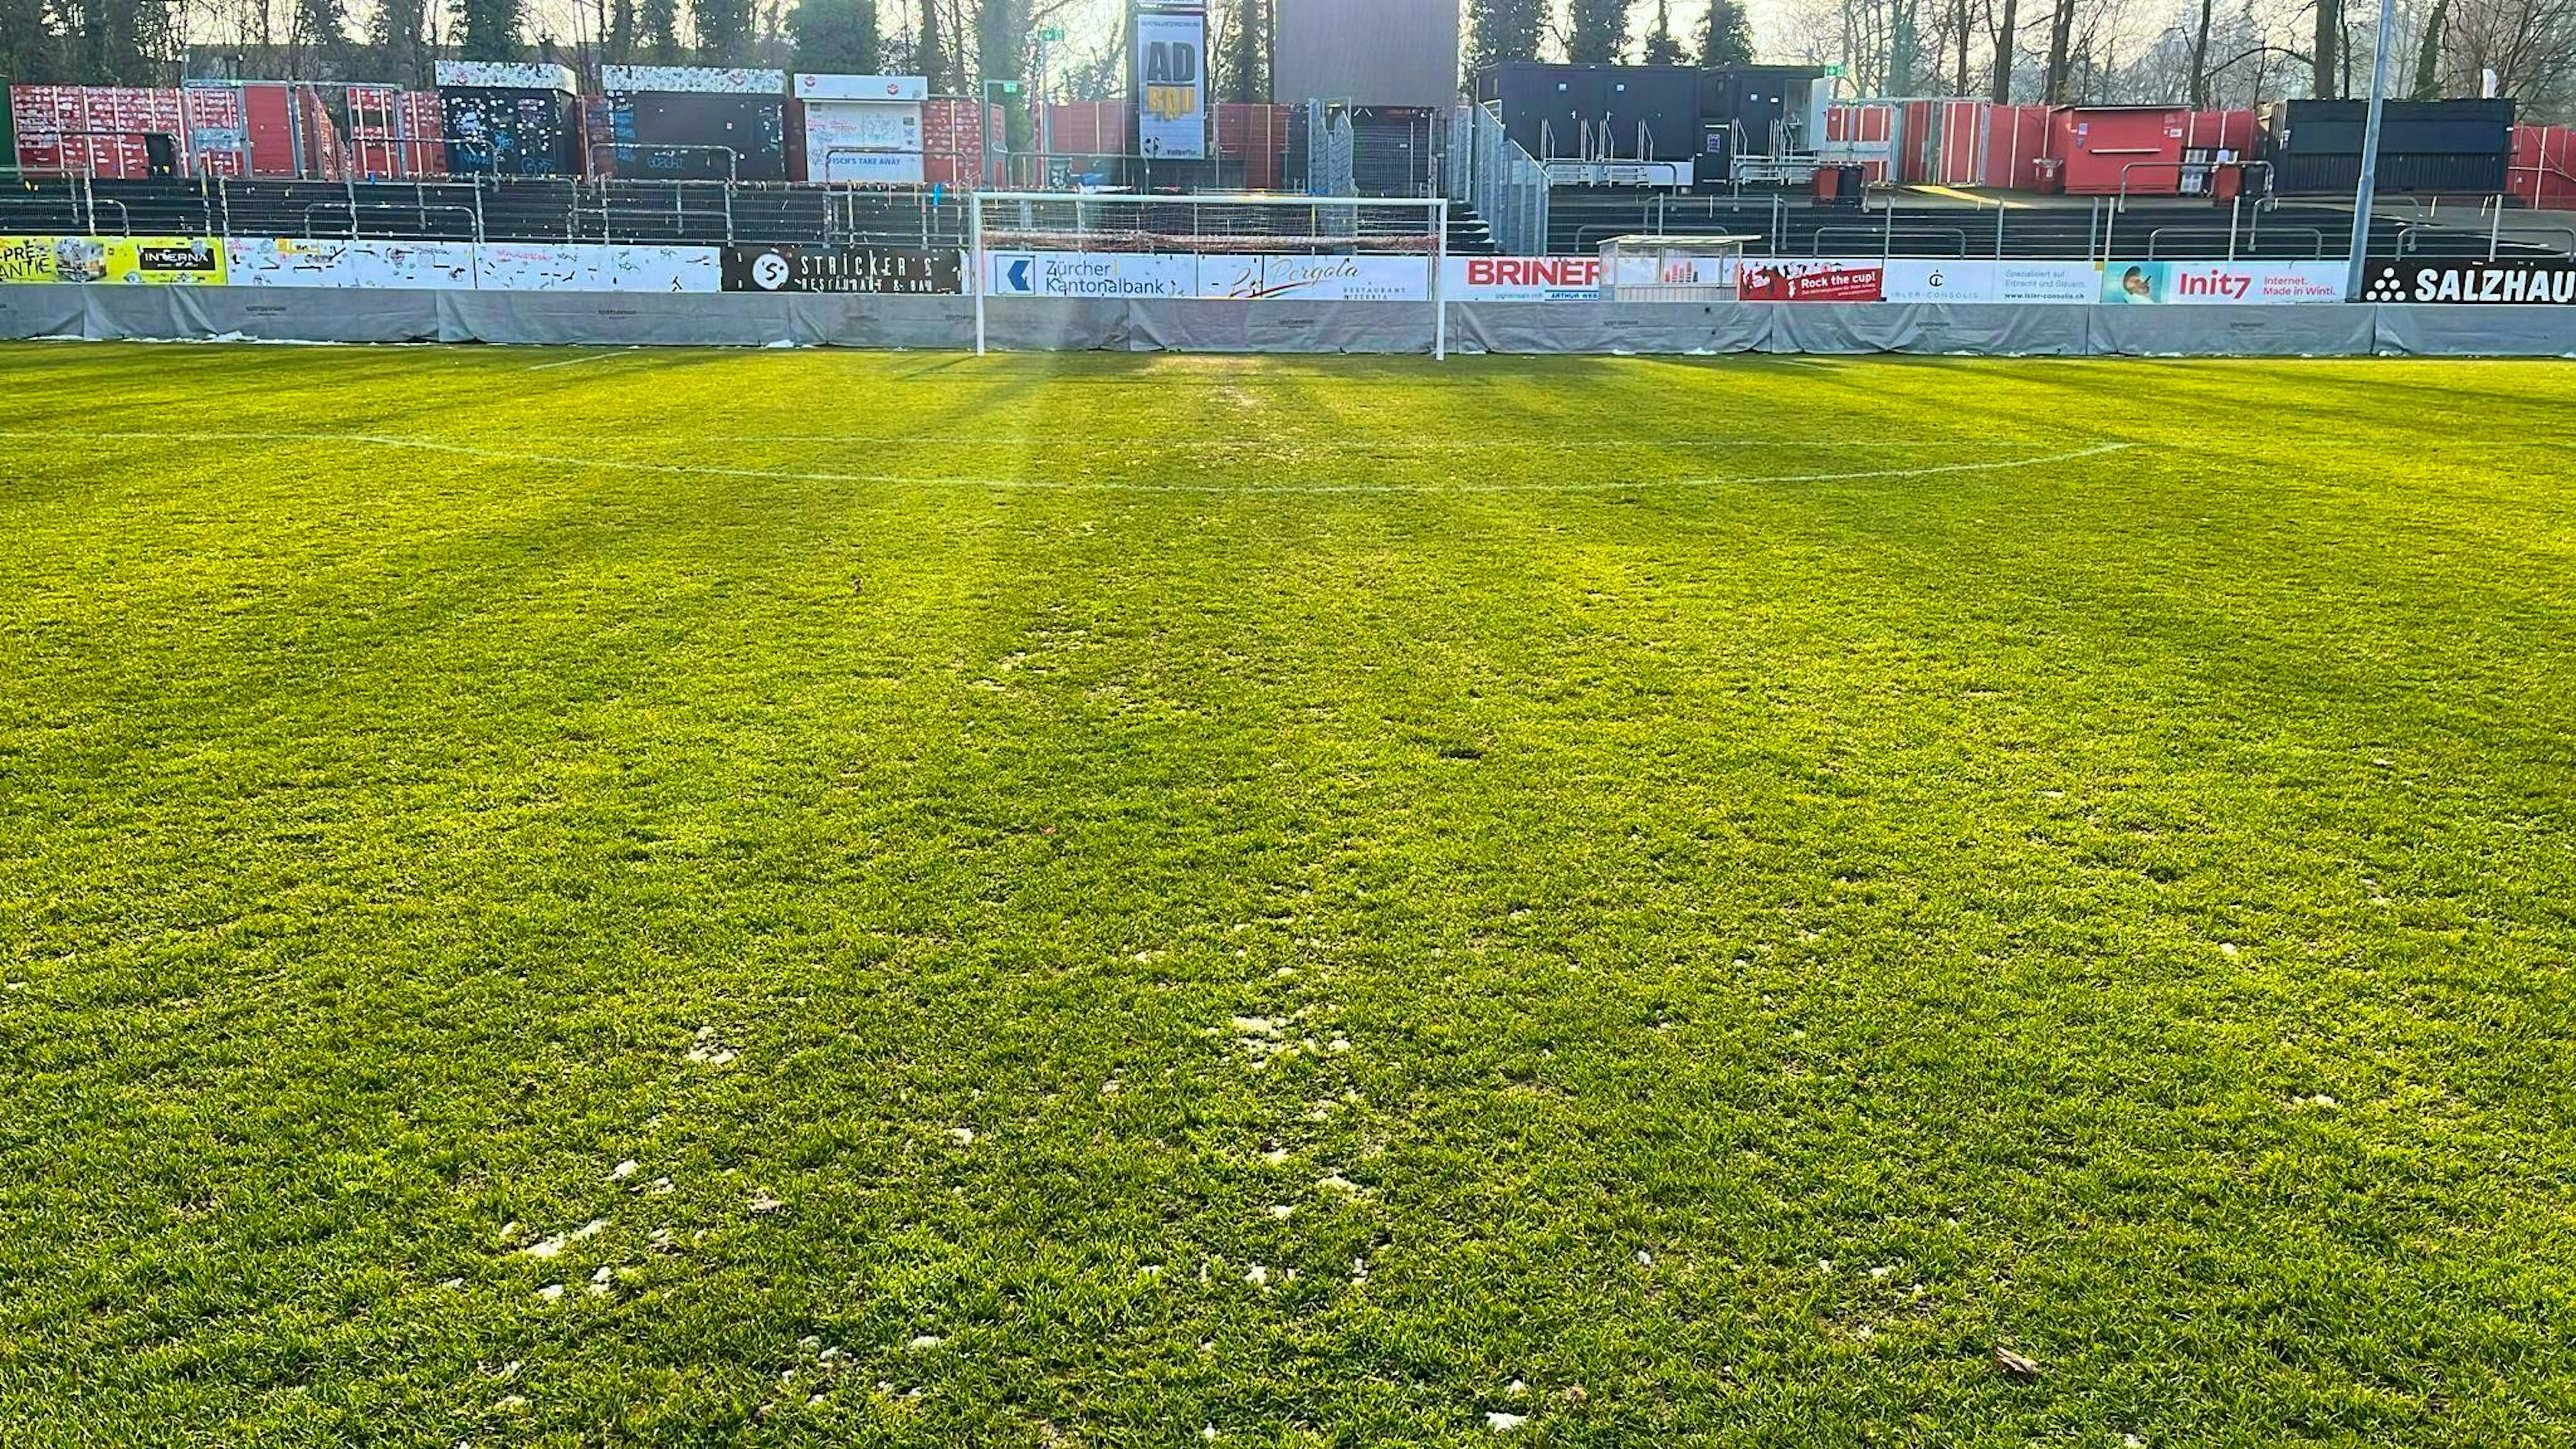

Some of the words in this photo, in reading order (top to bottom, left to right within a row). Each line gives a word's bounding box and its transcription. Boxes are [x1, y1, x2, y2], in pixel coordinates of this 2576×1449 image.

[1147, 42, 1195, 81] AD
[859, 157, 876, 165] TAKE
[879, 157, 901, 166] AWAY
[1046, 260, 1111, 276] Zürcher
[1270, 257, 1360, 283] Pergola
[1046, 278, 1165, 294] Kantonalbank
[1801, 276, 1828, 289] Rock
[1831, 275, 1850, 286] the
[1852, 272, 1876, 283] cup!
[2180, 270, 2251, 299] Init7
[2264, 276, 2308, 286] Internet.
[2263, 287, 2291, 295] Made
[2293, 286, 2303, 295] in
